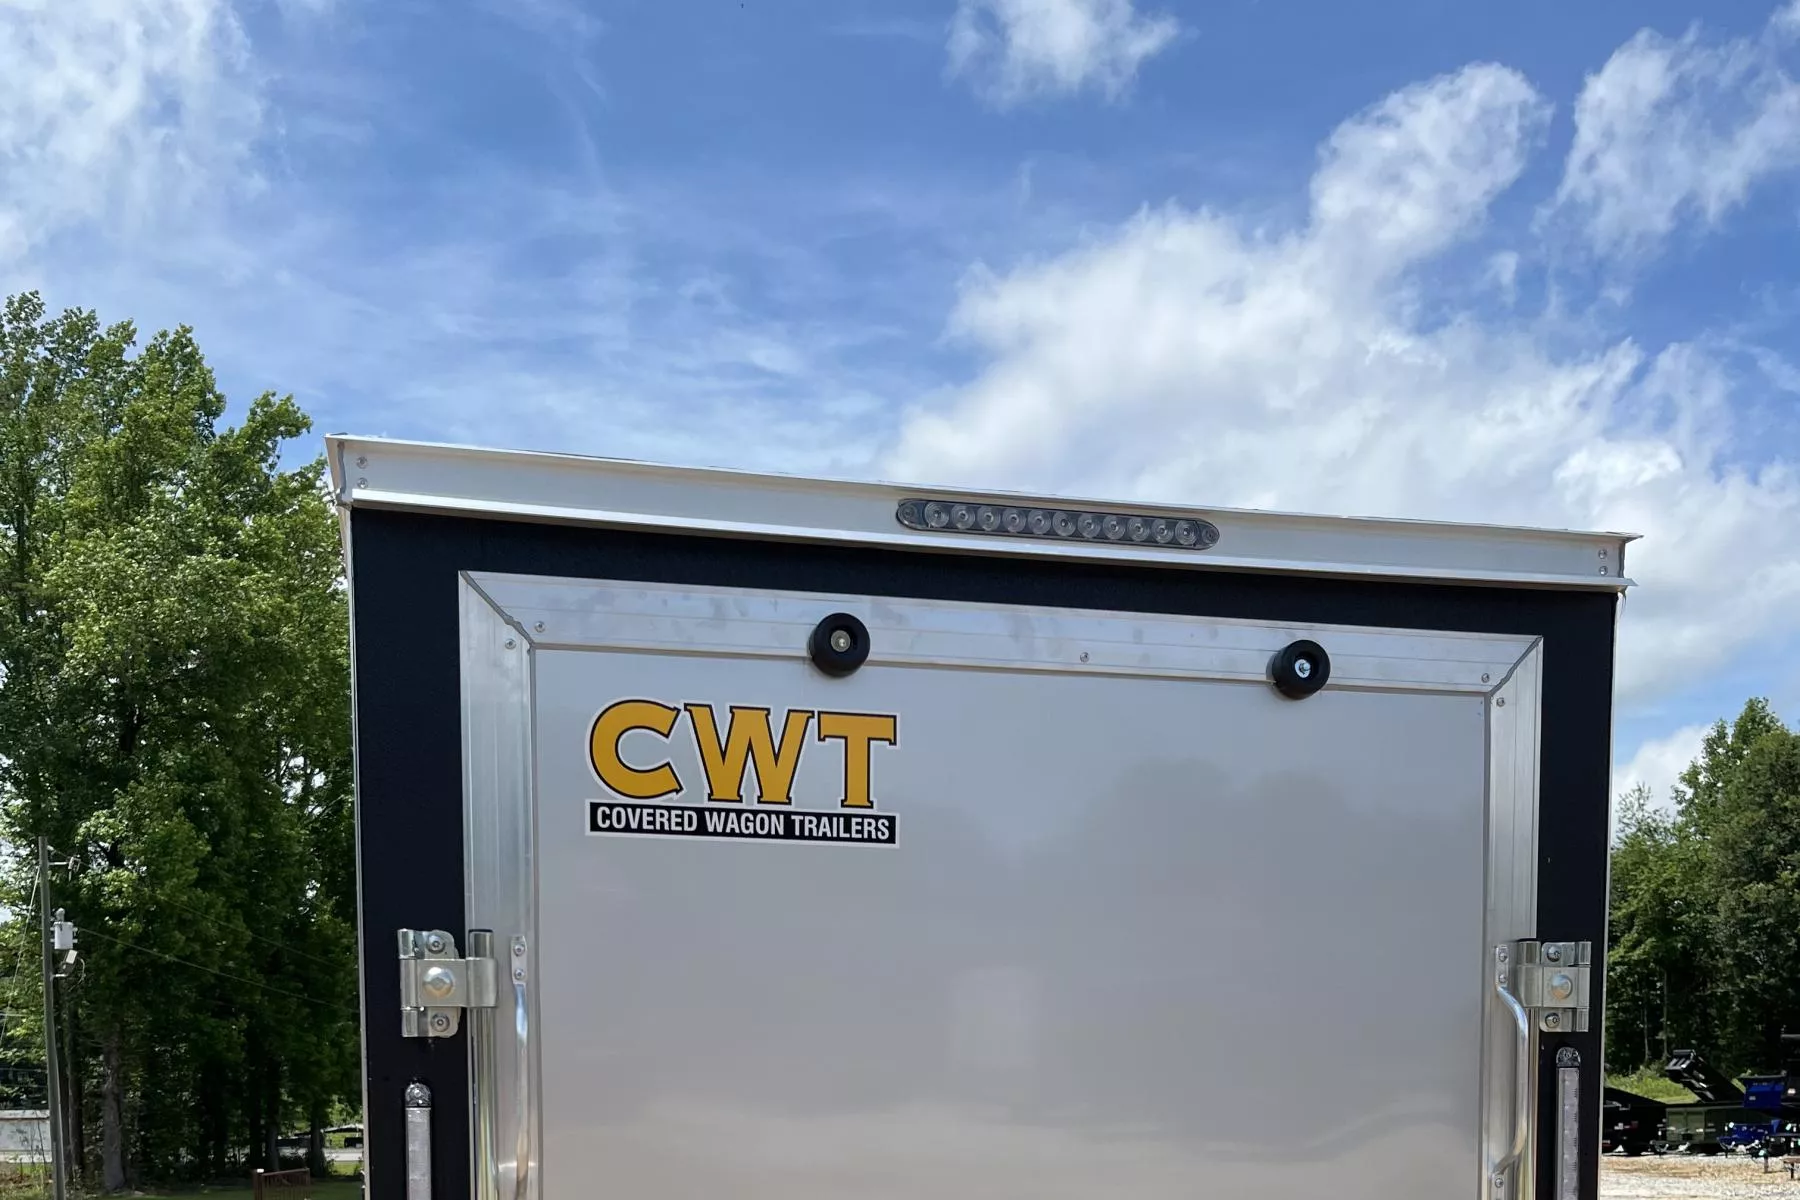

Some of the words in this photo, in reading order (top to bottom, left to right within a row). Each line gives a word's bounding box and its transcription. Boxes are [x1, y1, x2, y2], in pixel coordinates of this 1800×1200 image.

[589, 698, 898, 809] CWT
[596, 805, 699, 833] COVERED
[704, 810, 785, 836] WAGON
[790, 814, 890, 840] TRAILERS
